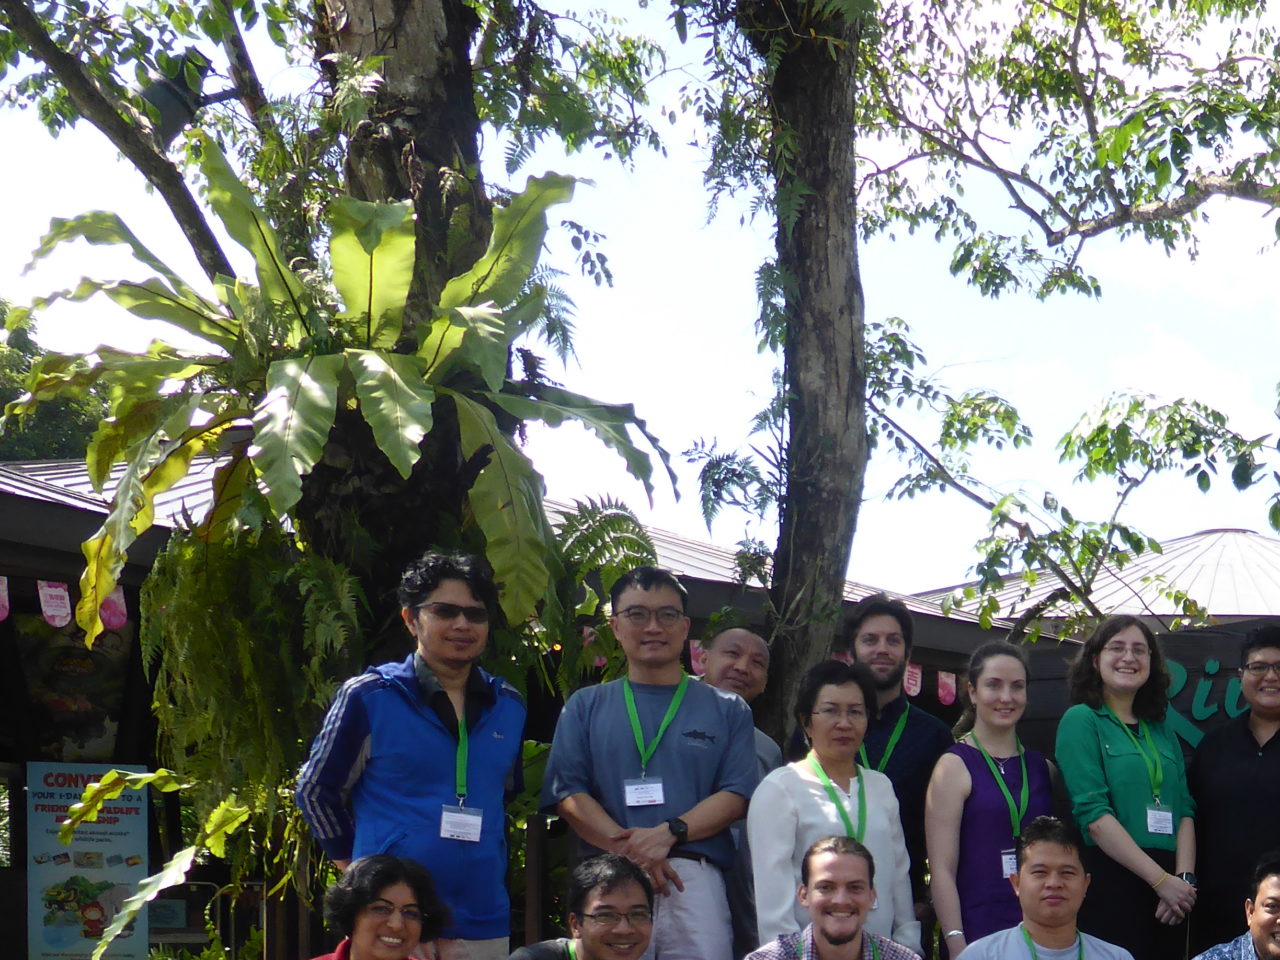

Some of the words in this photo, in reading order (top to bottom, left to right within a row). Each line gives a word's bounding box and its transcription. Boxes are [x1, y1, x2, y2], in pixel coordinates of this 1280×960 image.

[43, 772, 103, 788] CONVE
[32, 791, 55, 800] YOUR
[121, 794, 133, 802] TO
[34, 803, 70, 813] FRIEND
[98, 806, 140, 816] WILDLIFE
